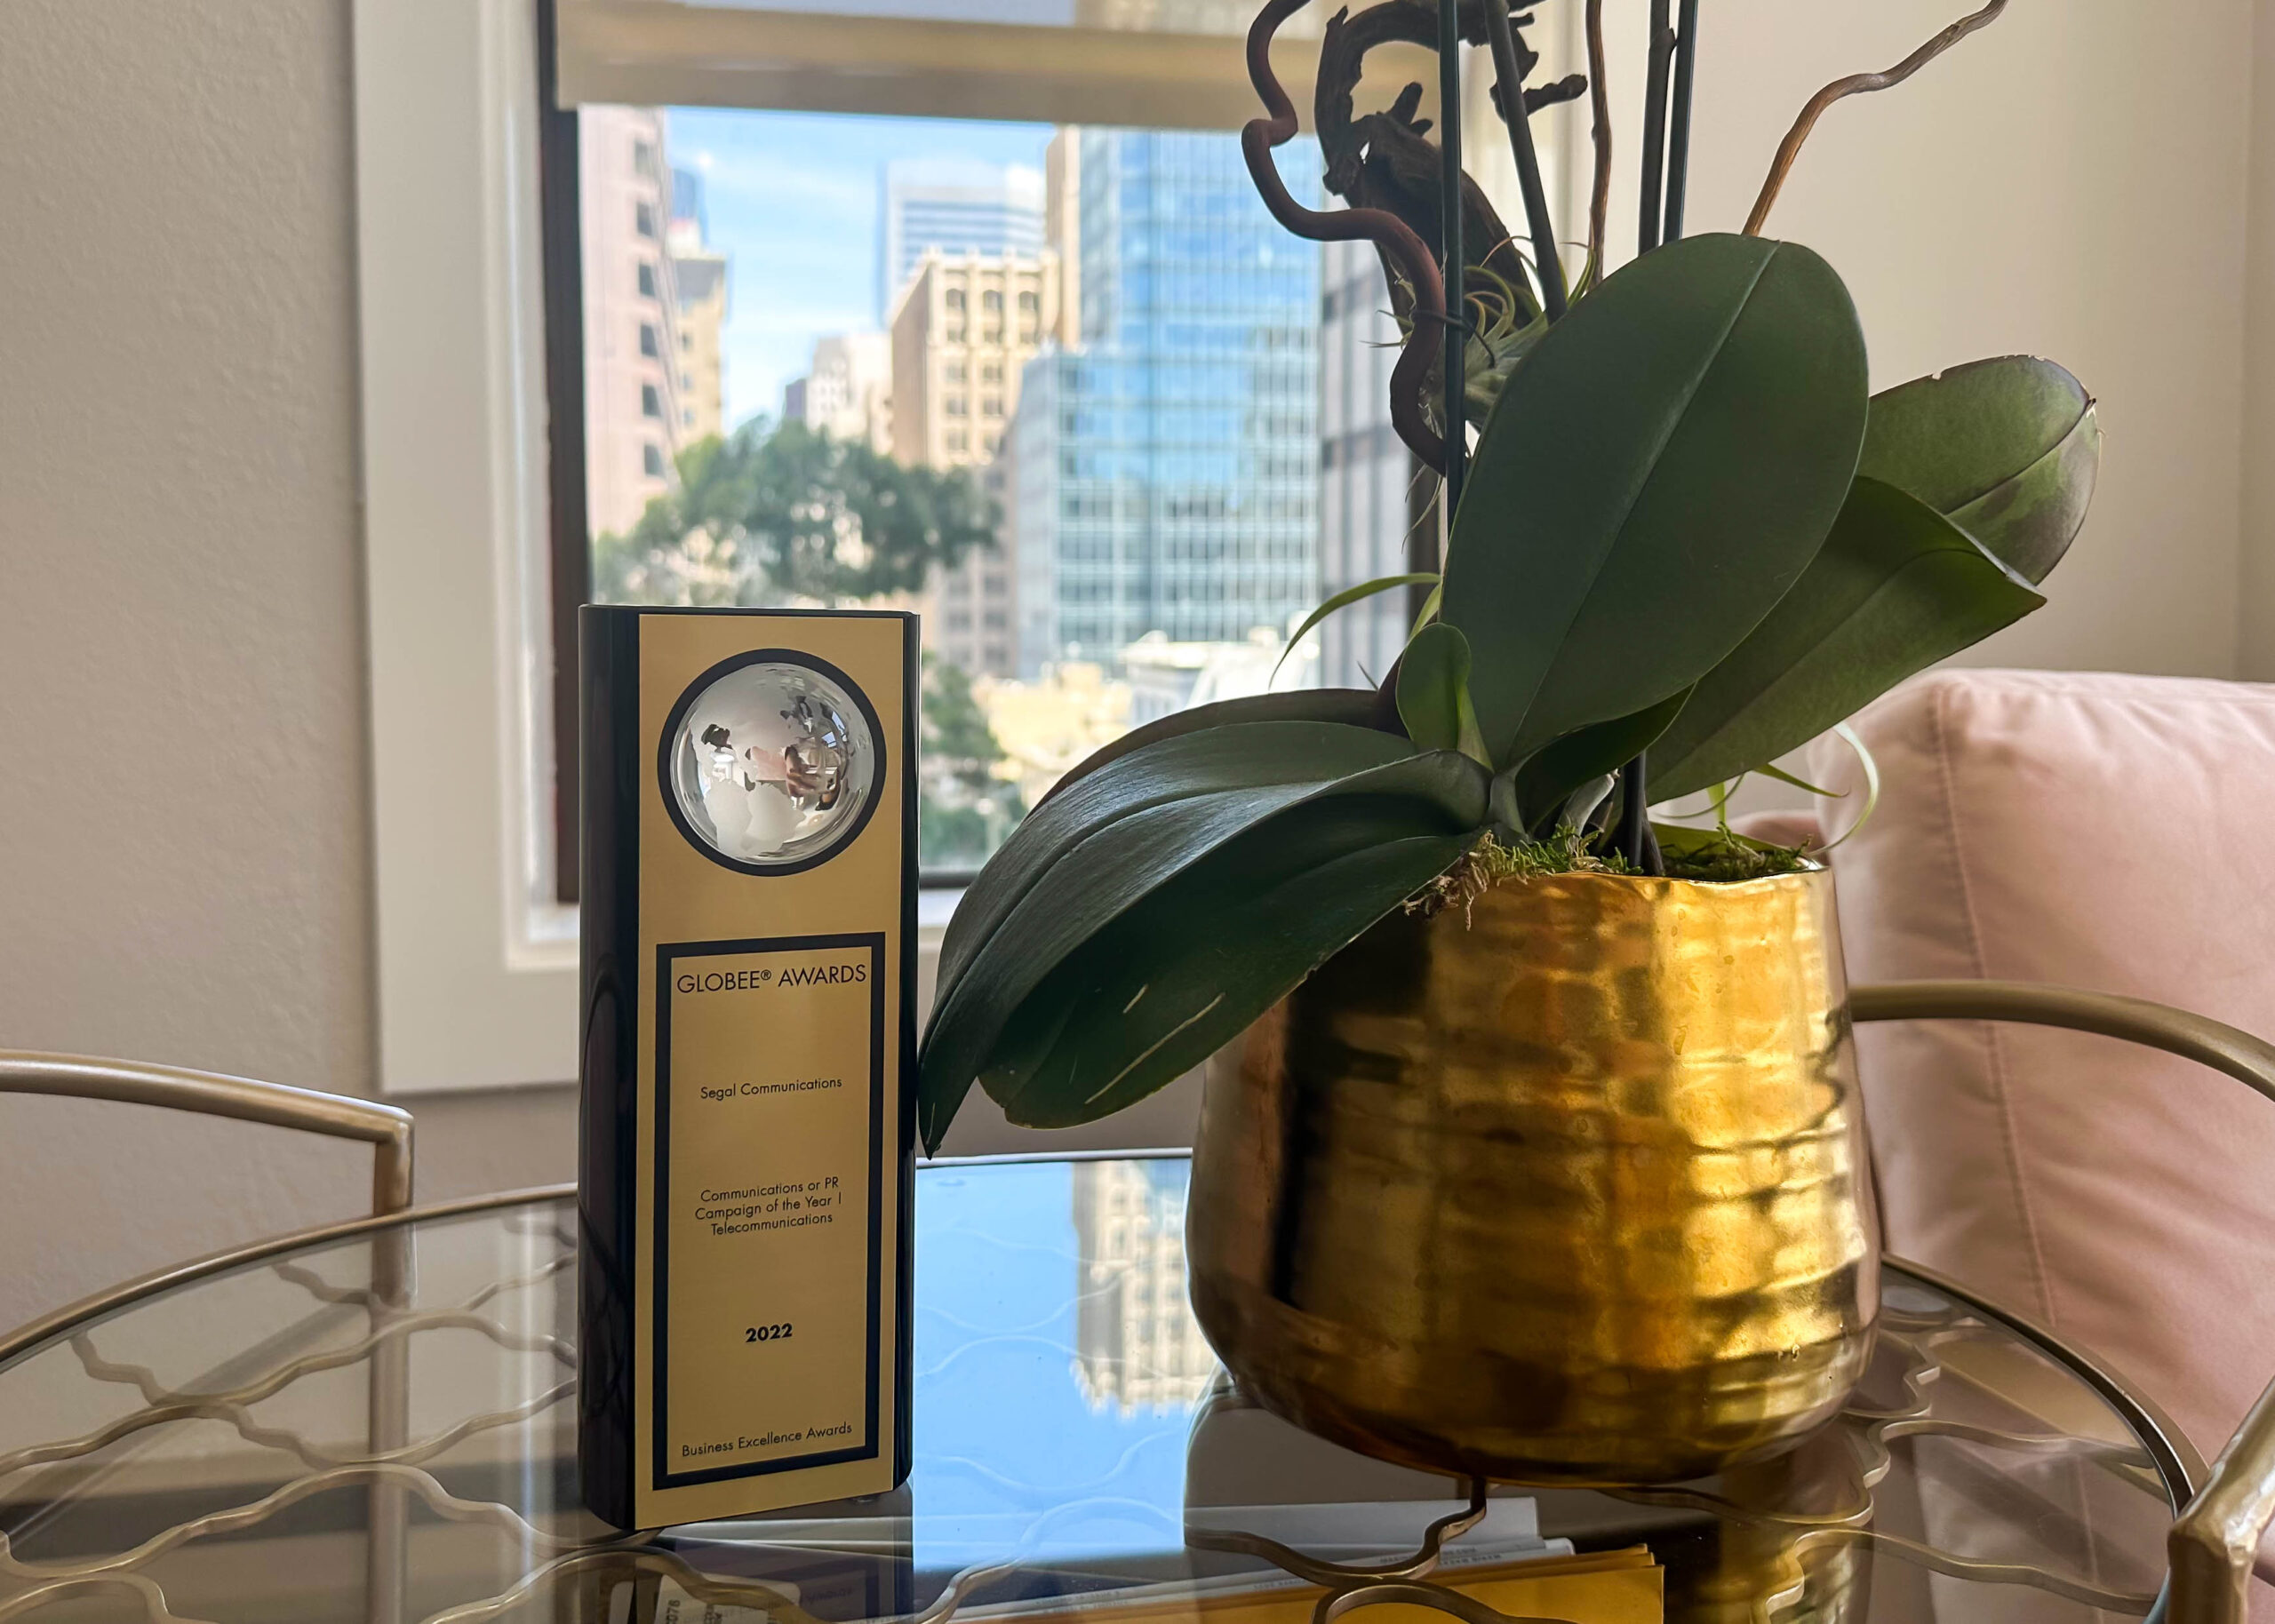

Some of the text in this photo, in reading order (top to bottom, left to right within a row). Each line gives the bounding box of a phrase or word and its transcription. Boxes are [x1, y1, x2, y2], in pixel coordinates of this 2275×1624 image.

[777, 963, 866, 988] AWARDS
[700, 1079, 842, 1102] Segal Communications
[700, 1175, 839, 1203] Communications or PR
[694, 1203, 762, 1222] Campaign
[765, 1198, 779, 1213] of
[782, 1197, 802, 1212] the
[804, 1195, 833, 1208] Year
[710, 1214, 833, 1237] Telecommunications
[745, 1322, 793, 1343] 2022
[682, 1421, 853, 1458] Business Excellence Awards
